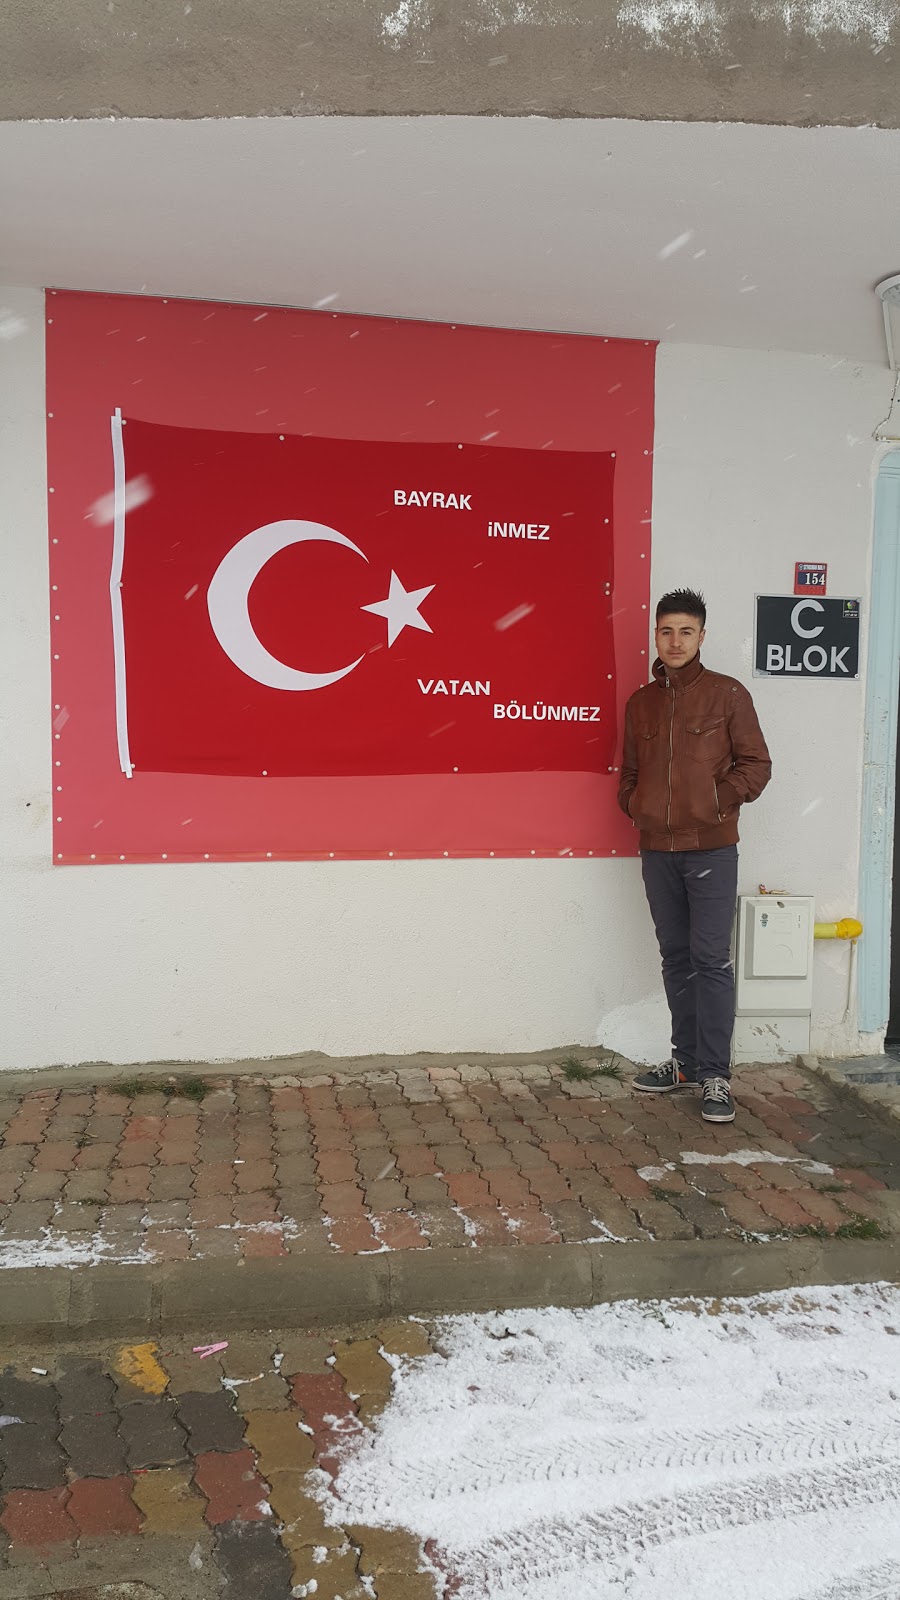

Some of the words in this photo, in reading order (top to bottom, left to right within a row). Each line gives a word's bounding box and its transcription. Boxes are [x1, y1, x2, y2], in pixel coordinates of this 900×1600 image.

[394, 490, 472, 510] BAYRAK
[805, 573, 825, 585] 154
[791, 599, 825, 639] C
[766, 644, 850, 673] BLOK
[417, 679, 491, 696] VATAN
[493, 700, 600, 721] BÖLÜNMEZ
